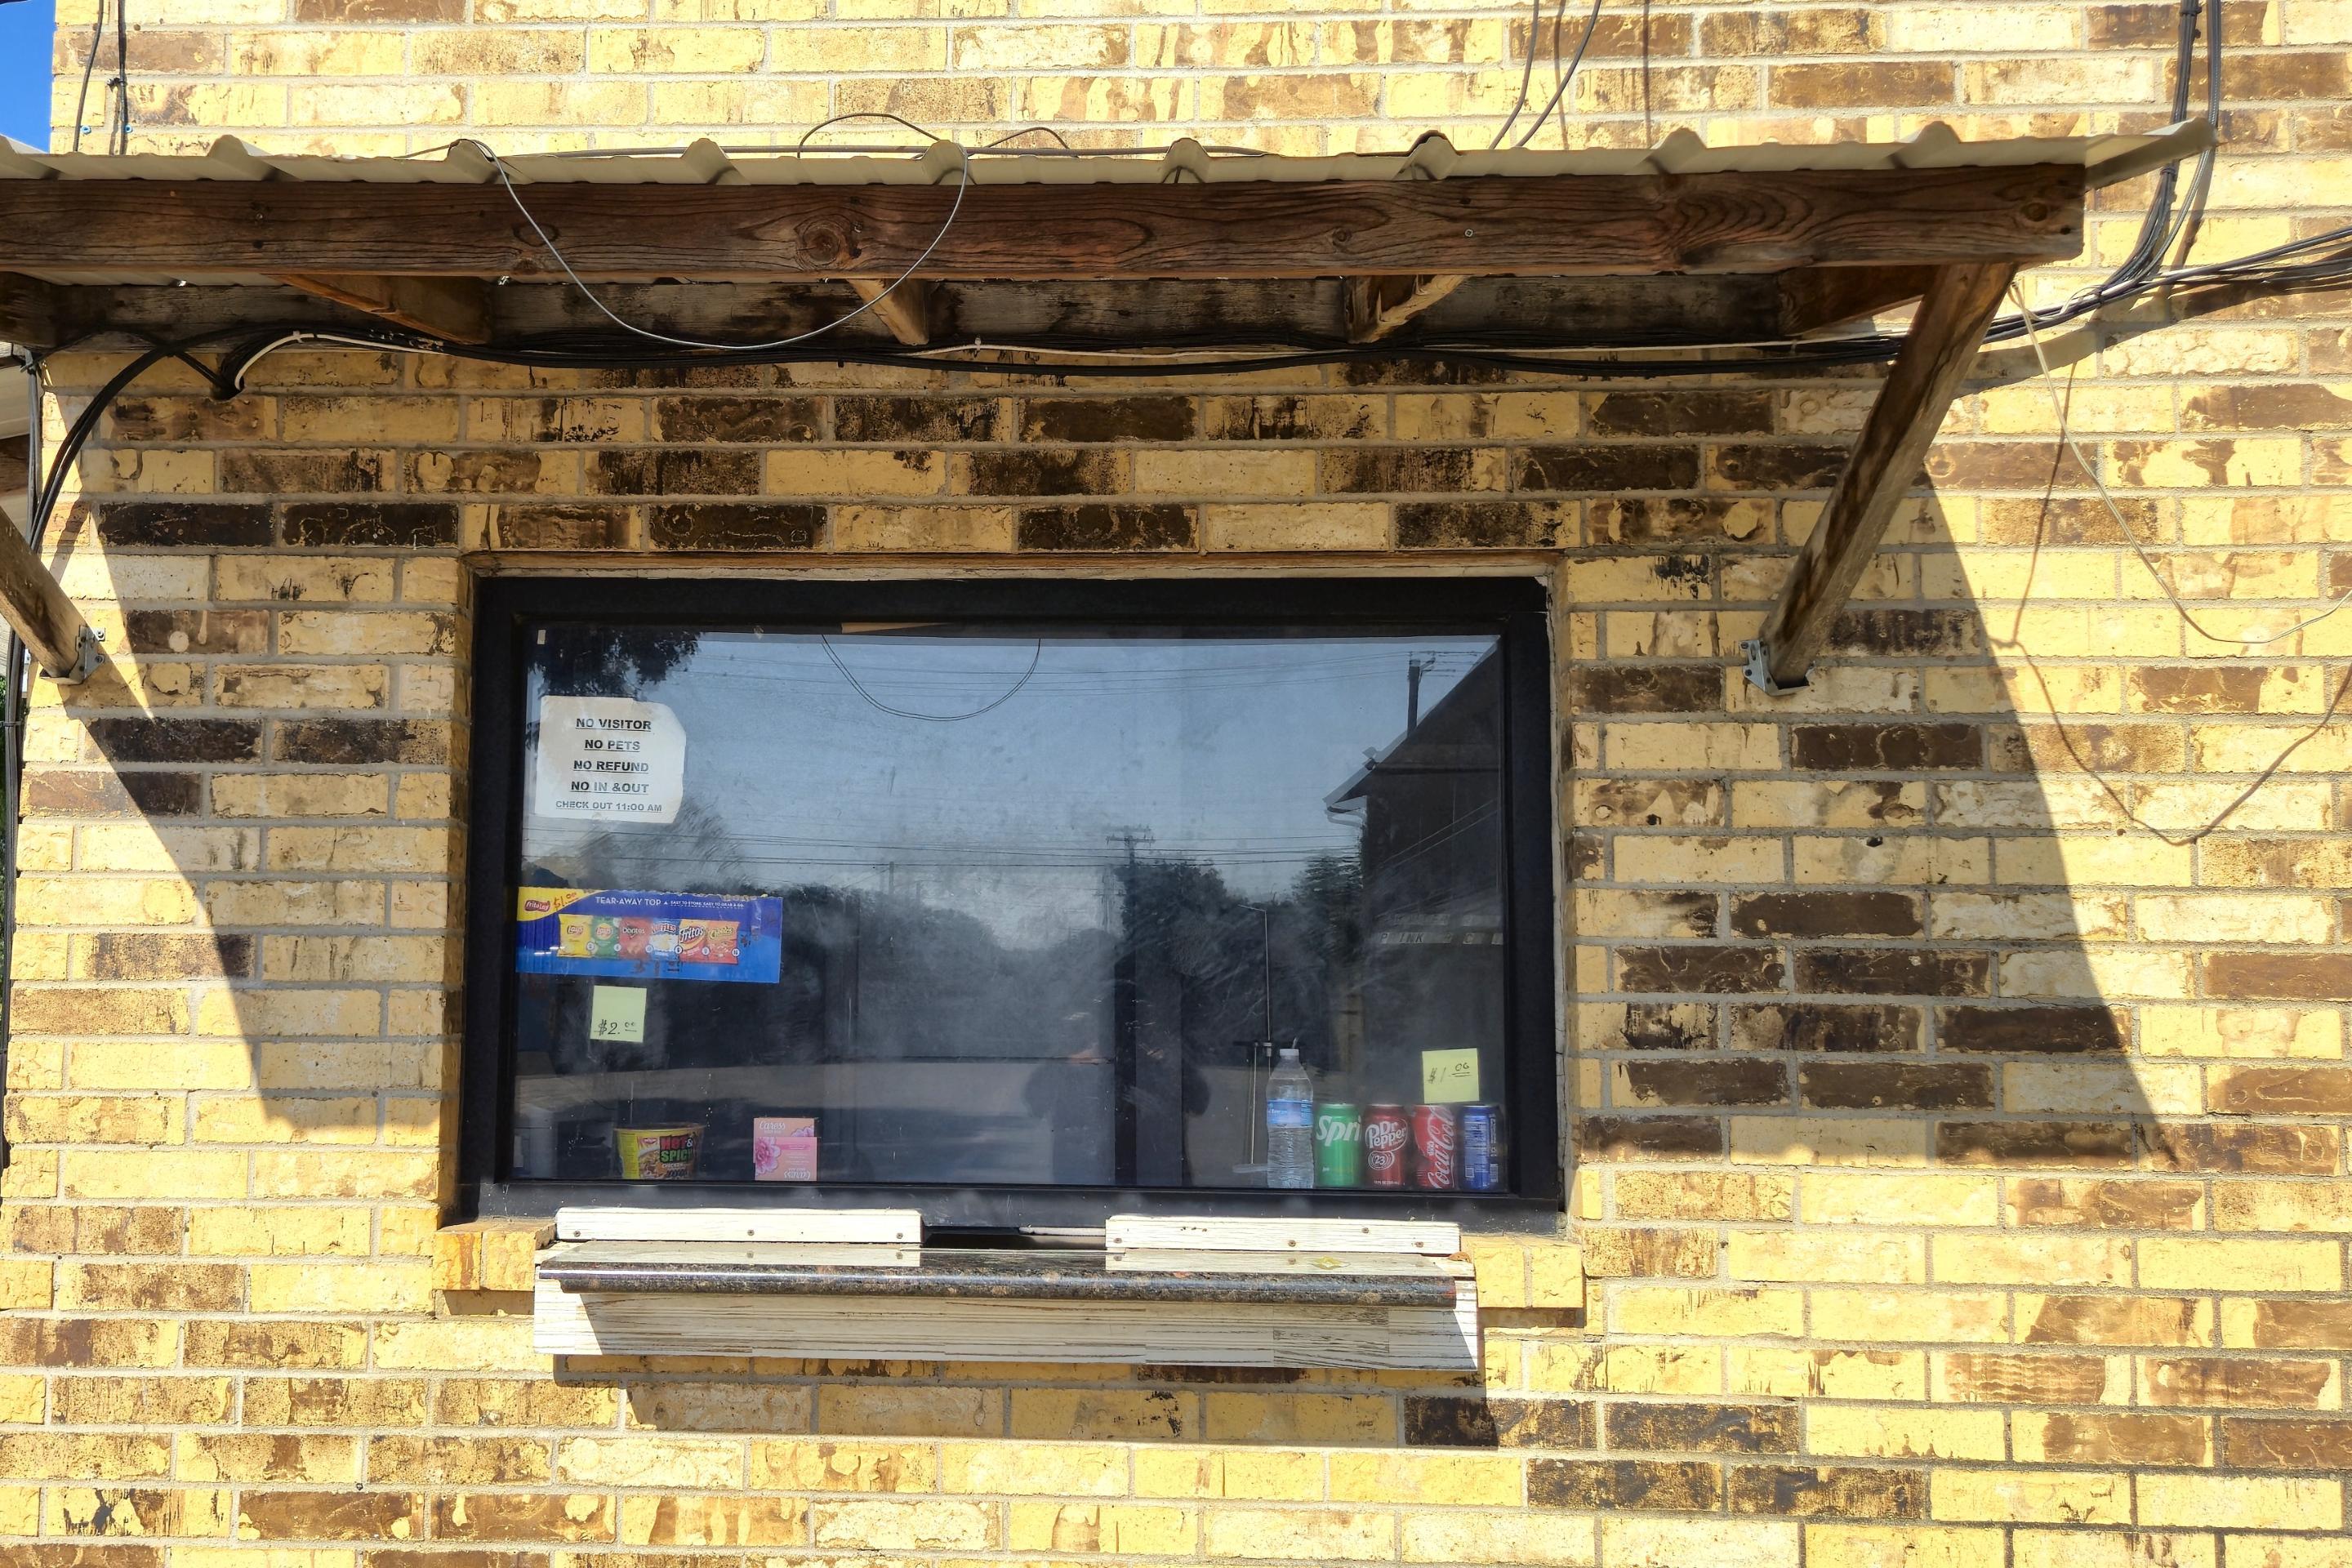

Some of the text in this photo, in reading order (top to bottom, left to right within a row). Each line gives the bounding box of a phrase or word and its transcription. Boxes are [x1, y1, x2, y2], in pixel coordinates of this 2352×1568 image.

[576, 718, 652, 730] NO VISITOR
[585, 739, 640, 751] NO PETS
[573, 760, 649, 772] NO REFUND
[571, 782, 590, 791] NO
[594, 782, 608, 791] IN
[555, 800, 589, 808] CHECK
[616, 803, 644, 811] 11:00
[647, 804, 662, 812] AM
[679, 925, 706, 942] Fritos
[1379, 1121, 1398, 1133] Dr
[1365, 1124, 1406, 1150] Pepper
[1374, 1155, 1386, 1165] 23
